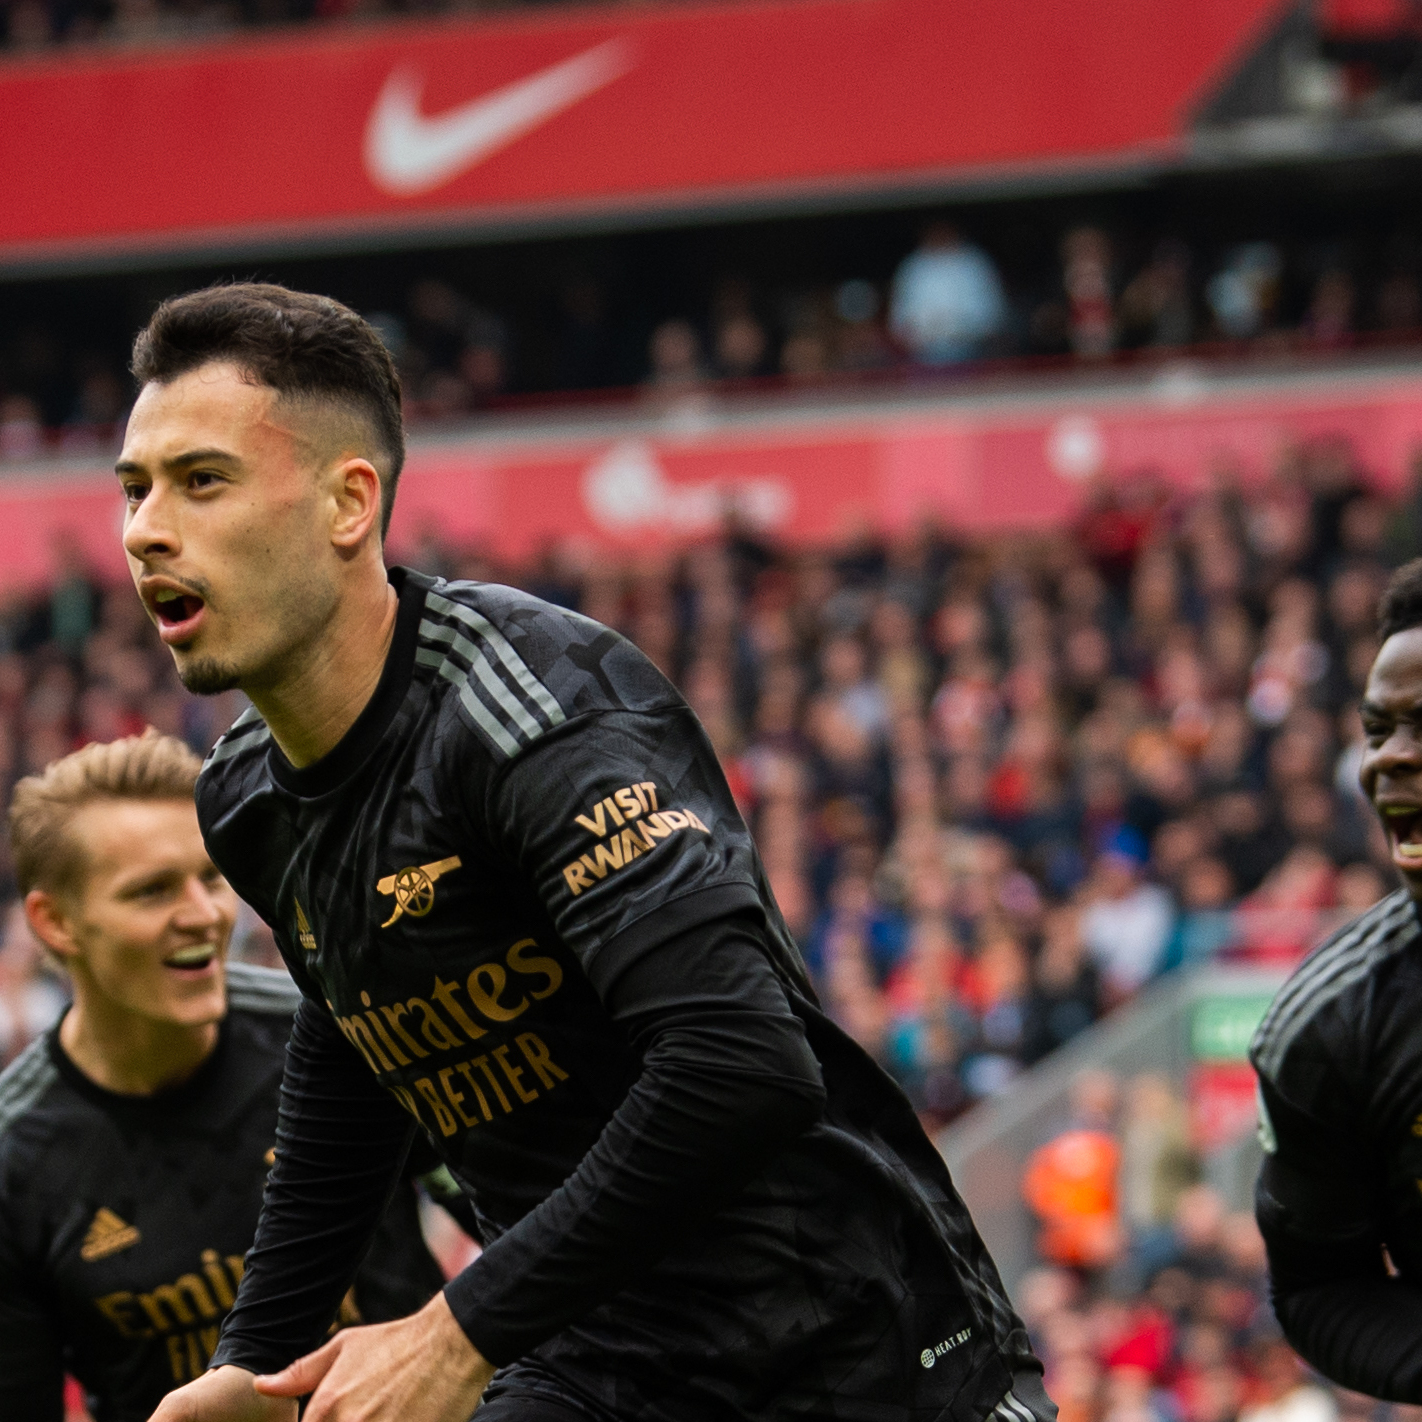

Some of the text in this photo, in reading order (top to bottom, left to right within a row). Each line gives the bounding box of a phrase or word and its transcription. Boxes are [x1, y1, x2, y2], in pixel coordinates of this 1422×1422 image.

[562, 808, 712, 897] RWANDA
[574, 781, 658, 839] VISIT
[325, 938, 564, 1075] mirates
[414, 1032, 570, 1138] BETTER
